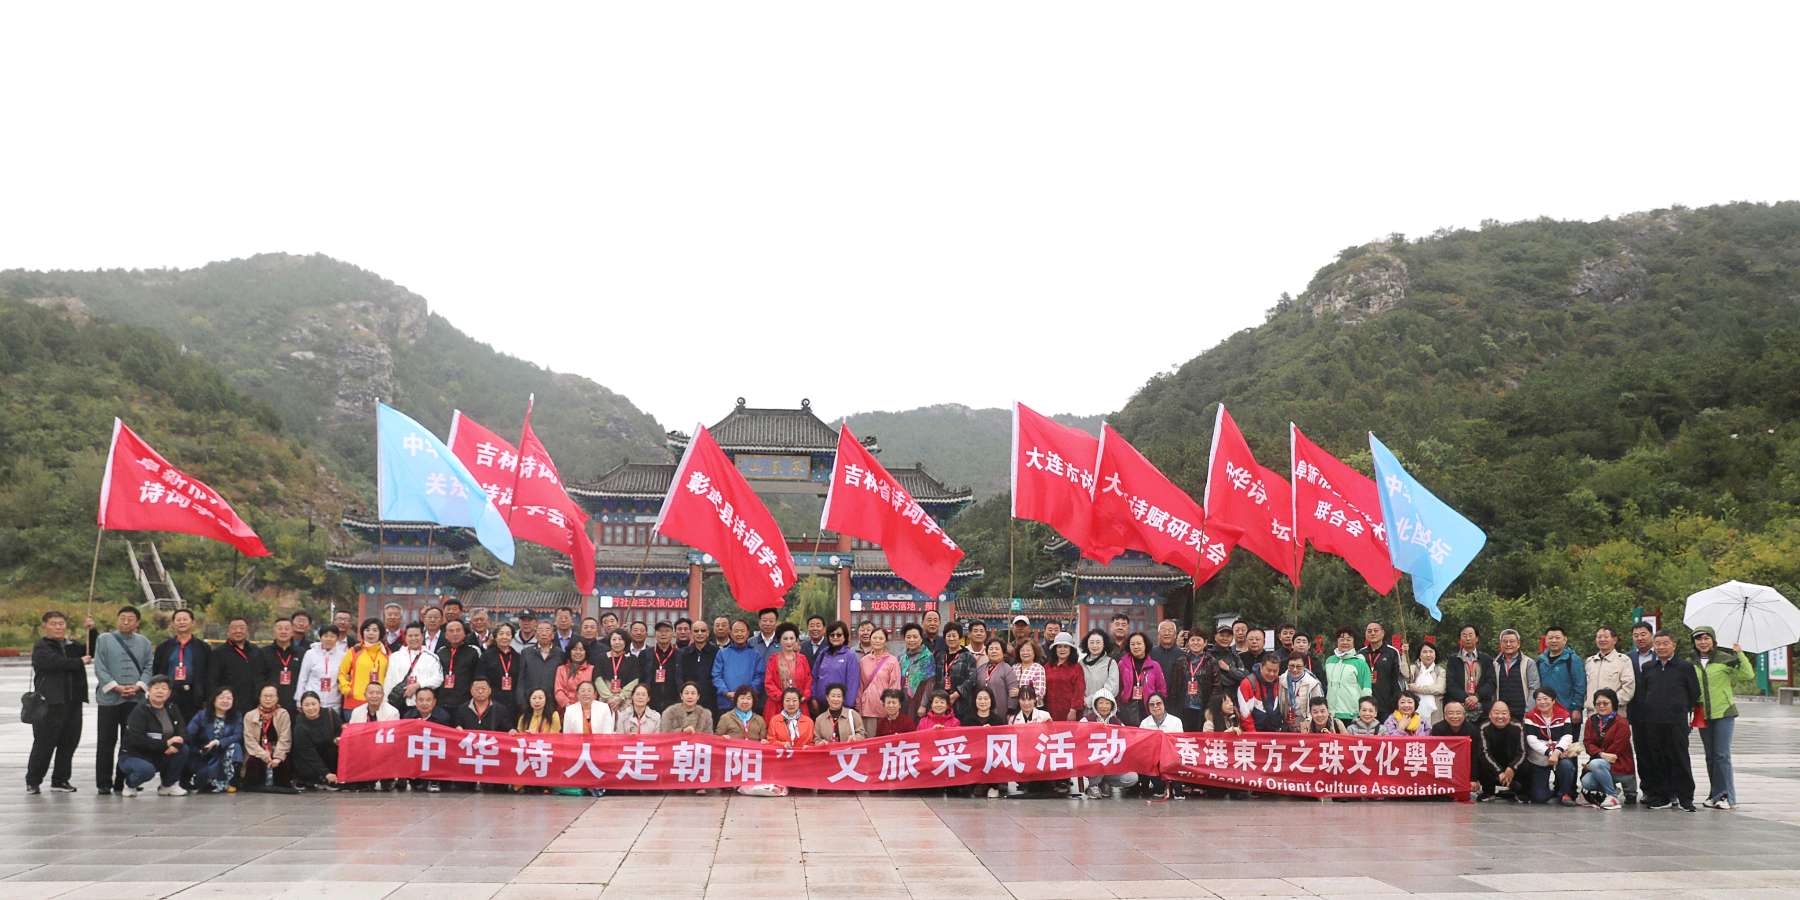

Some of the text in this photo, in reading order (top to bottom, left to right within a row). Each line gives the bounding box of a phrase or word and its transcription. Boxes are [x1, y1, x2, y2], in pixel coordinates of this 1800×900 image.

[686, 471, 784, 588] 彰武县诗词学会
[1102, 471, 1228, 566] 大诗赋研究会
[1313, 499, 1364, 537] 联合会
[827, 728, 1128, 784] 文旅采风活动
[1175, 737, 1457, 779] 香港東方之珠文化學會
[1266, 778, 1311, 793] Orient
[1314, 780, 1367, 795] Culture
[1371, 782, 1456, 796] Association
